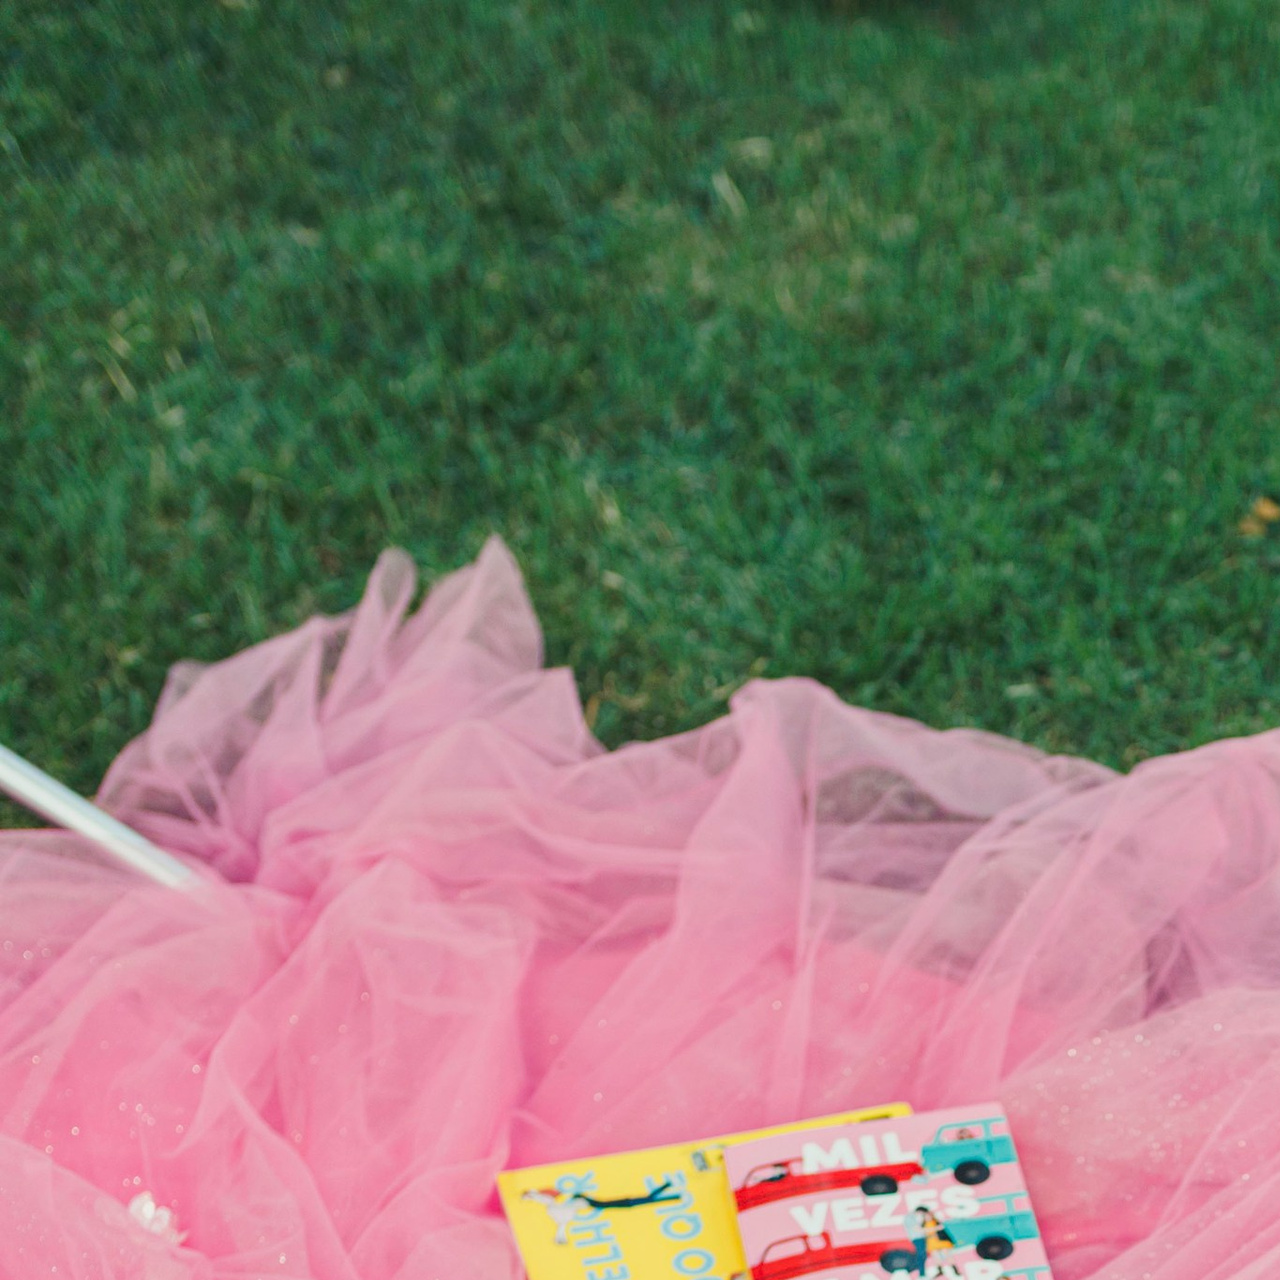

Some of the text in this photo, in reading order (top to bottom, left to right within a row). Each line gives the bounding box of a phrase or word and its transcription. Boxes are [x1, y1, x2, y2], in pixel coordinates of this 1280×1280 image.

[801, 1131, 918, 1174] MIL
[643, 1170, 703, 1241] QUE
[789, 1186, 981, 1236] VEZES
